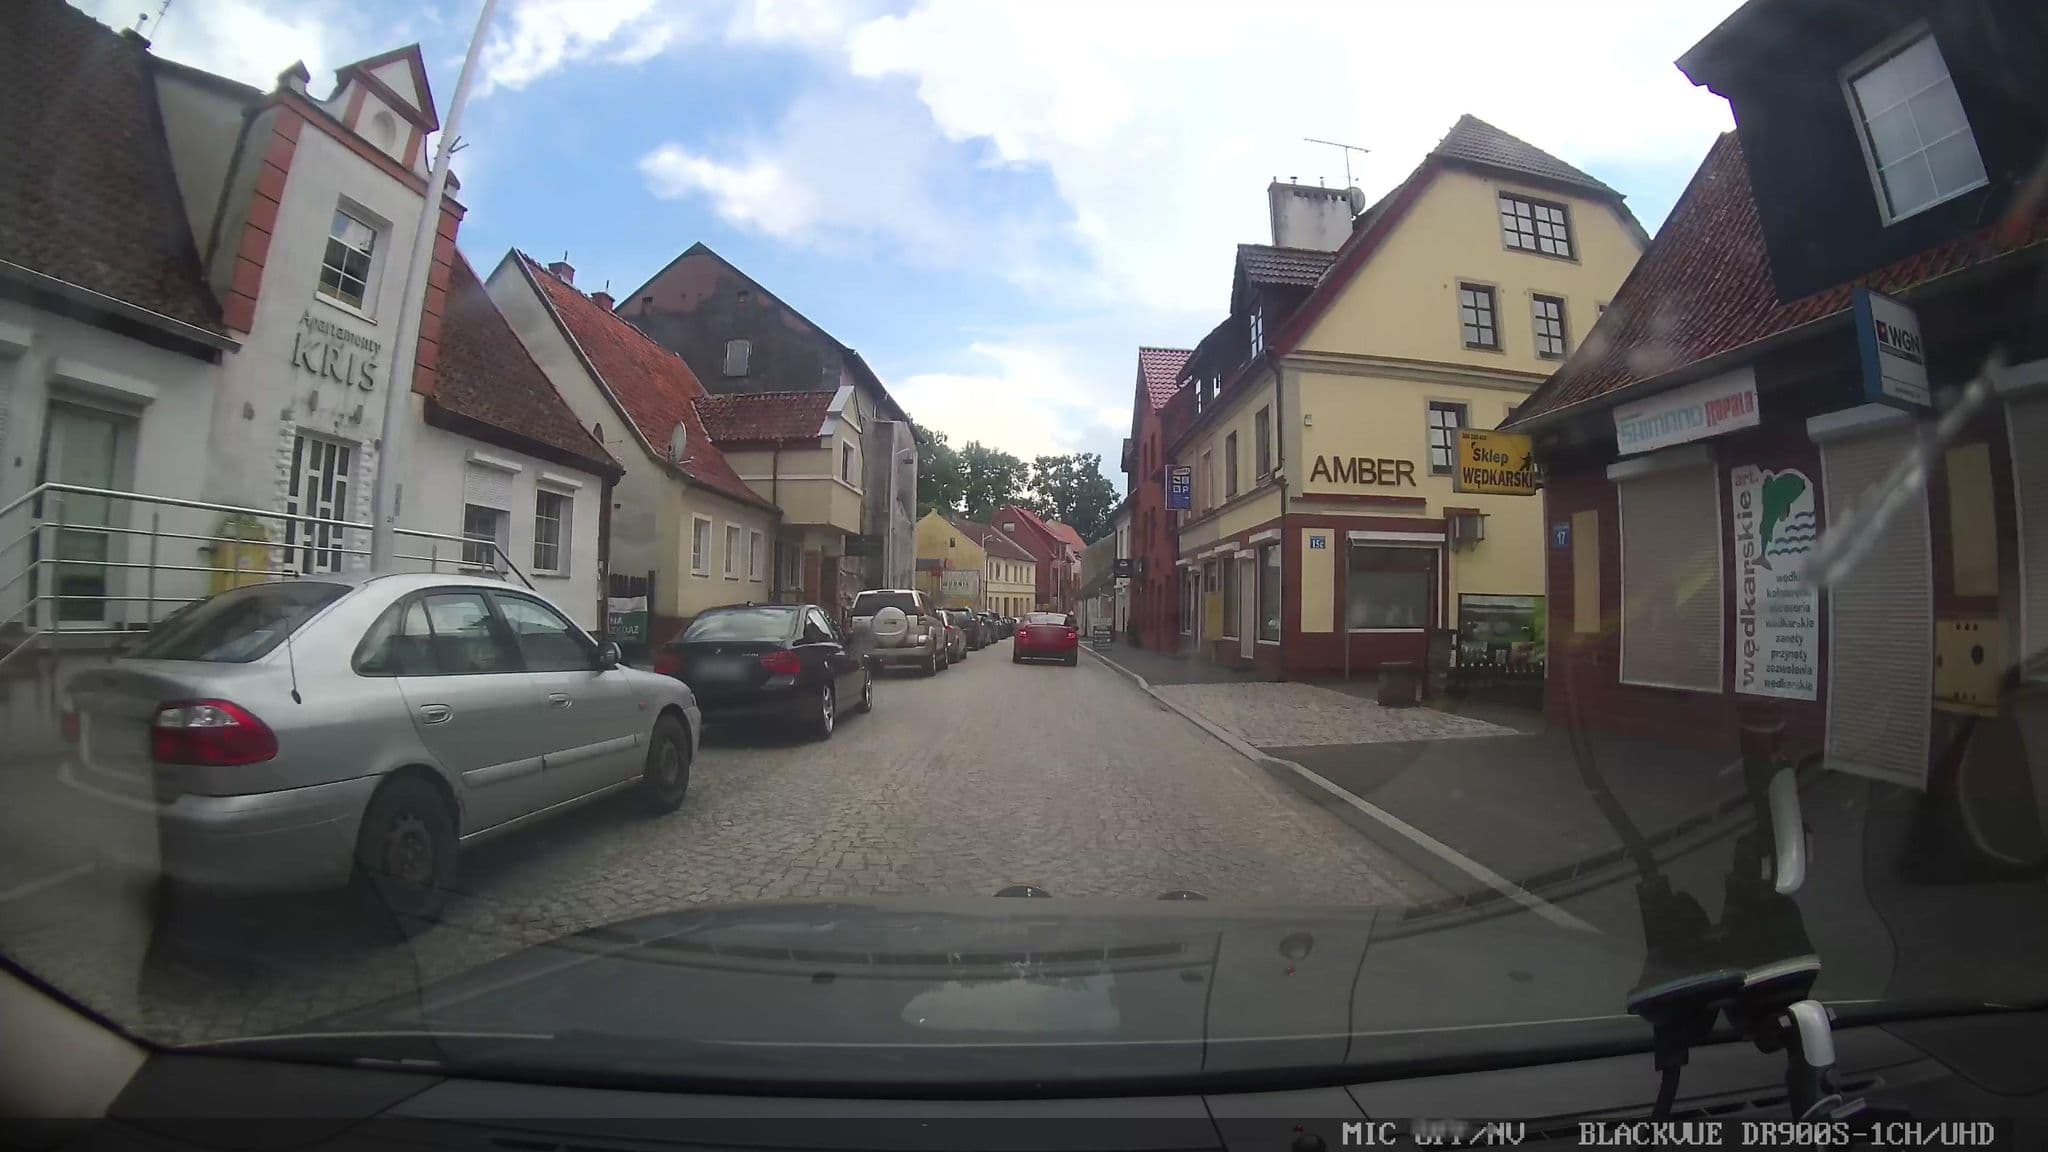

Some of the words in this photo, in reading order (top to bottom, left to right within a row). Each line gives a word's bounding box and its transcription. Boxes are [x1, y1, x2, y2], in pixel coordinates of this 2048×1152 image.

[1888, 325, 1921, 353] WGN
[292, 332, 378, 392] KRIS
[1472, 446, 1509, 467] Sklep
[1310, 455, 1417, 487] AMBER
[1463, 467, 1533, 488] WĘDKARSKI
[1557, 531, 1566, 545] 17
[1737, 490, 1760, 687] wędkarskie
